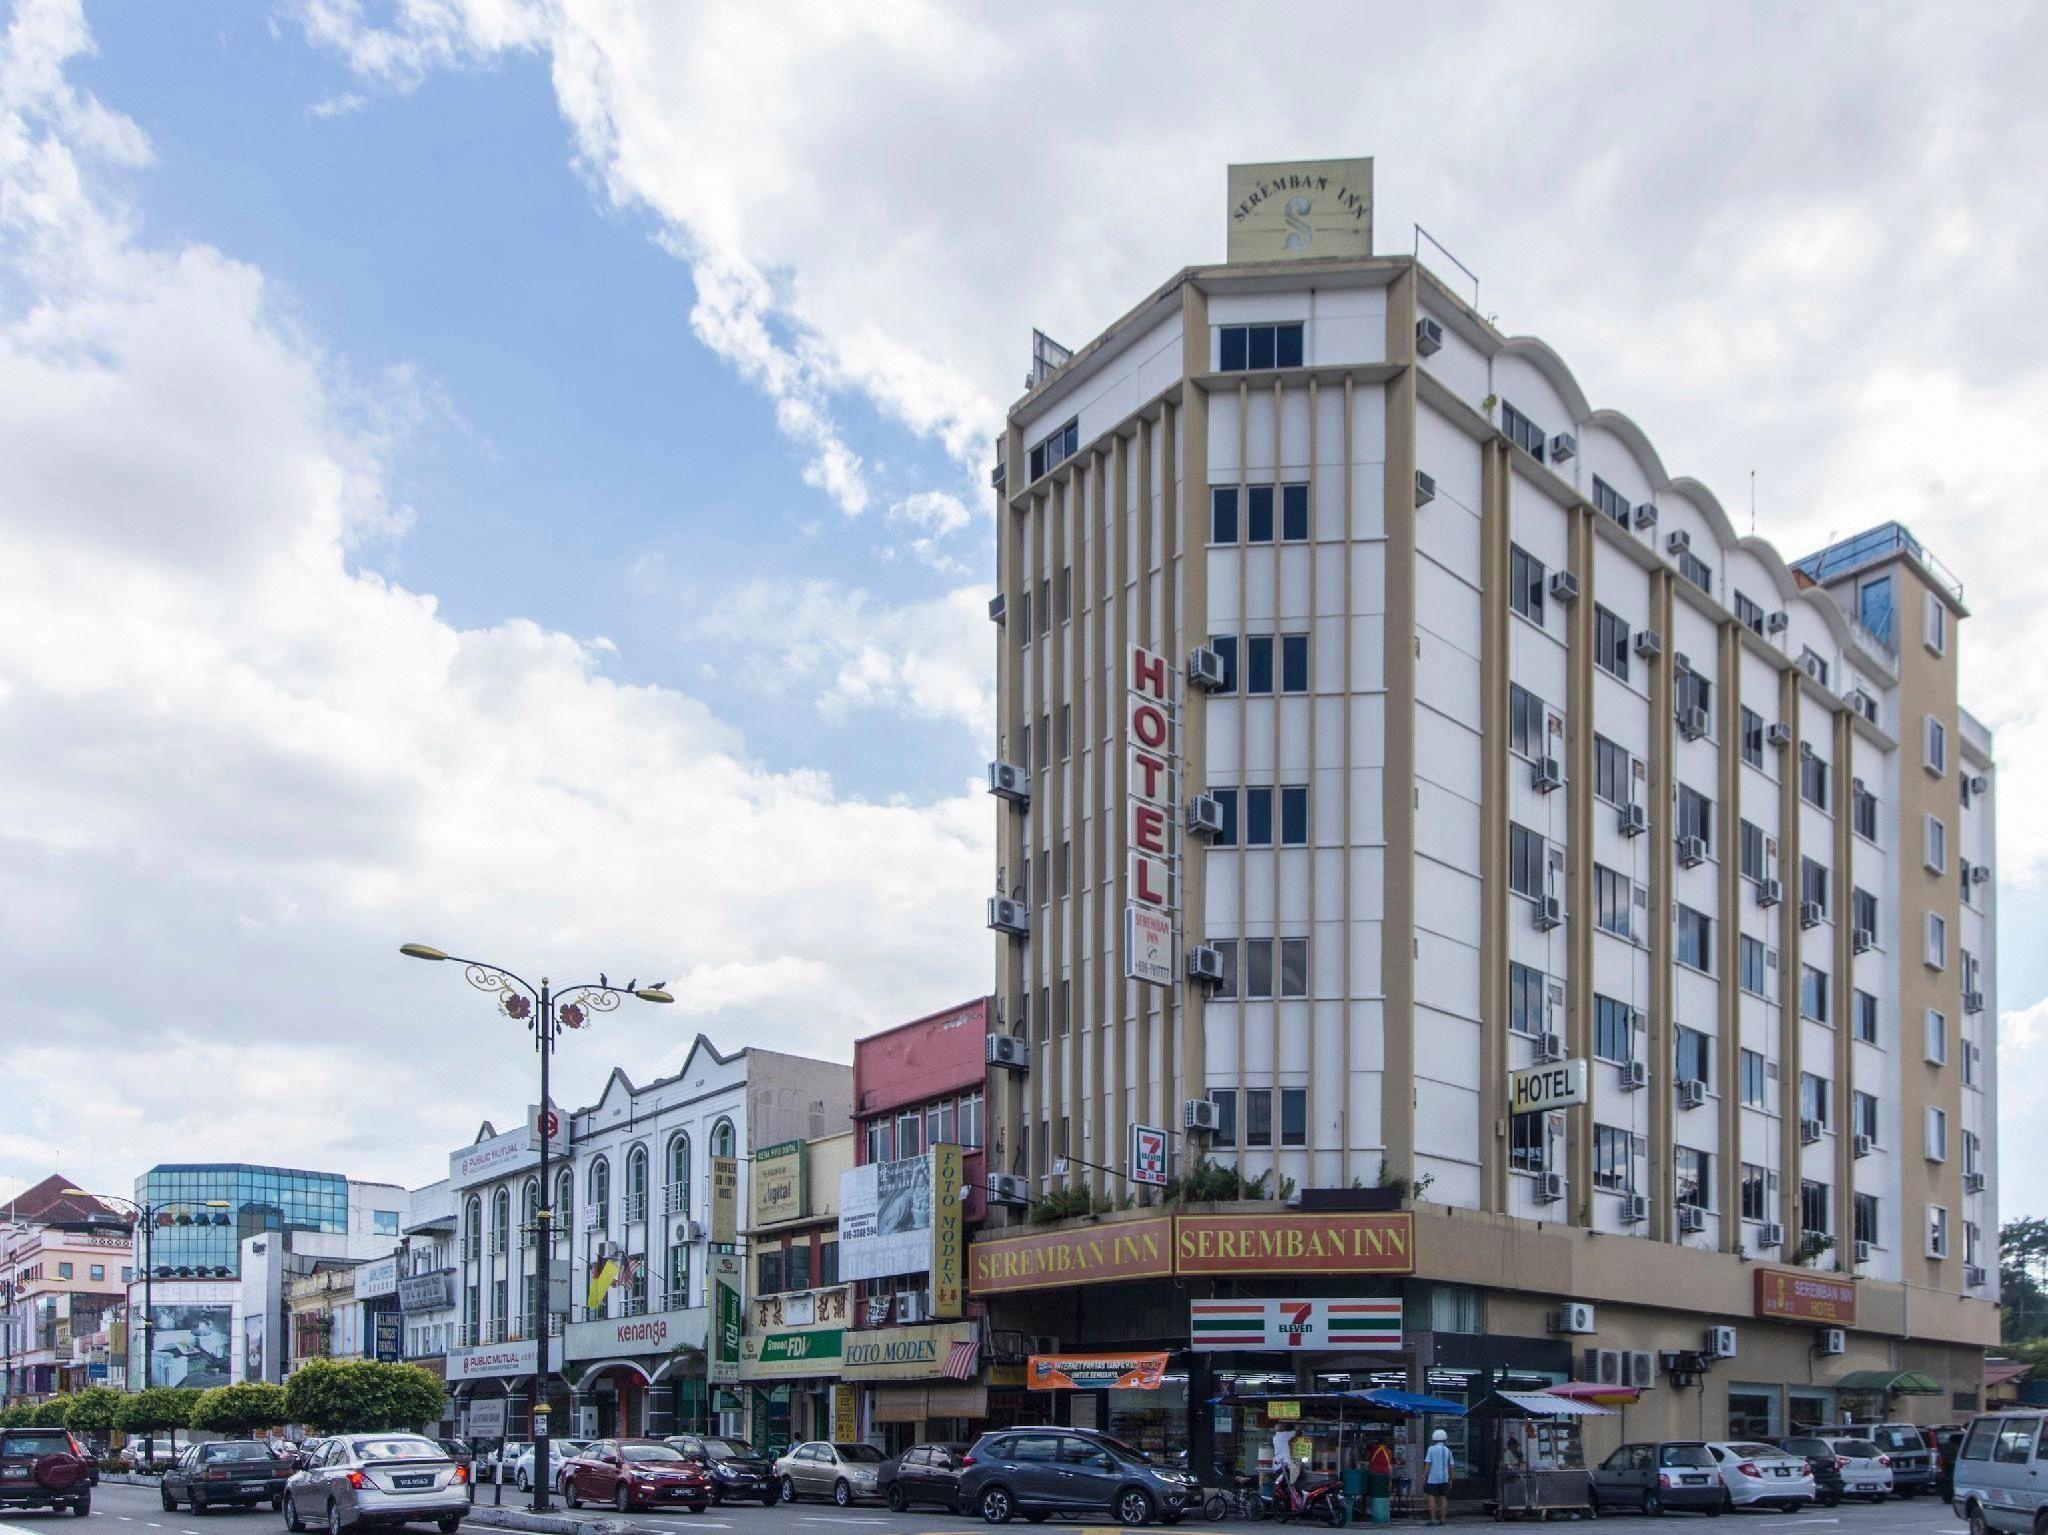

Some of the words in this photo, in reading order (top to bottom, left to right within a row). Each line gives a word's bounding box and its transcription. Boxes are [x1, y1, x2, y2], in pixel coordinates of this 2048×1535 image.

[1233, 174, 1329, 223] SEREMBAN
[1337, 186, 1369, 221] INN
[1134, 649, 1167, 905] HOTEL
[1135, 912, 1170, 936] SEREMBAN
[1146, 931, 1160, 946] INN
[1517, 1068, 1575, 1105] HOTEL
[469, 1152, 491, 1168] PUBLIC
[491, 1143, 519, 1160] MUTUAL
[1142, 1134, 1161, 1171] 7
[942, 1152, 956, 1208] FOTO
[941, 1216, 956, 1285] MODEN
[978, 1239, 1105, 1280] SEREMBAN
[1114, 1232, 1160, 1265] INN
[1180, 1228, 1347, 1258] SEREMBAN
[1353, 1228, 1406, 1256] INN
[1794, 1280, 1838, 1301] SEREMBAN
[1279, 1302, 1313, 1346] 7
[378, 1340, 397, 1353] DENTAL
[470, 1355, 492, 1367] PUBLIC
[492, 1353, 520, 1364] MUTUAL
[786, 1335, 806, 1357] FDI
[846, 1343, 880, 1363] FOTO
[883, 1339, 937, 1361] MODEN
